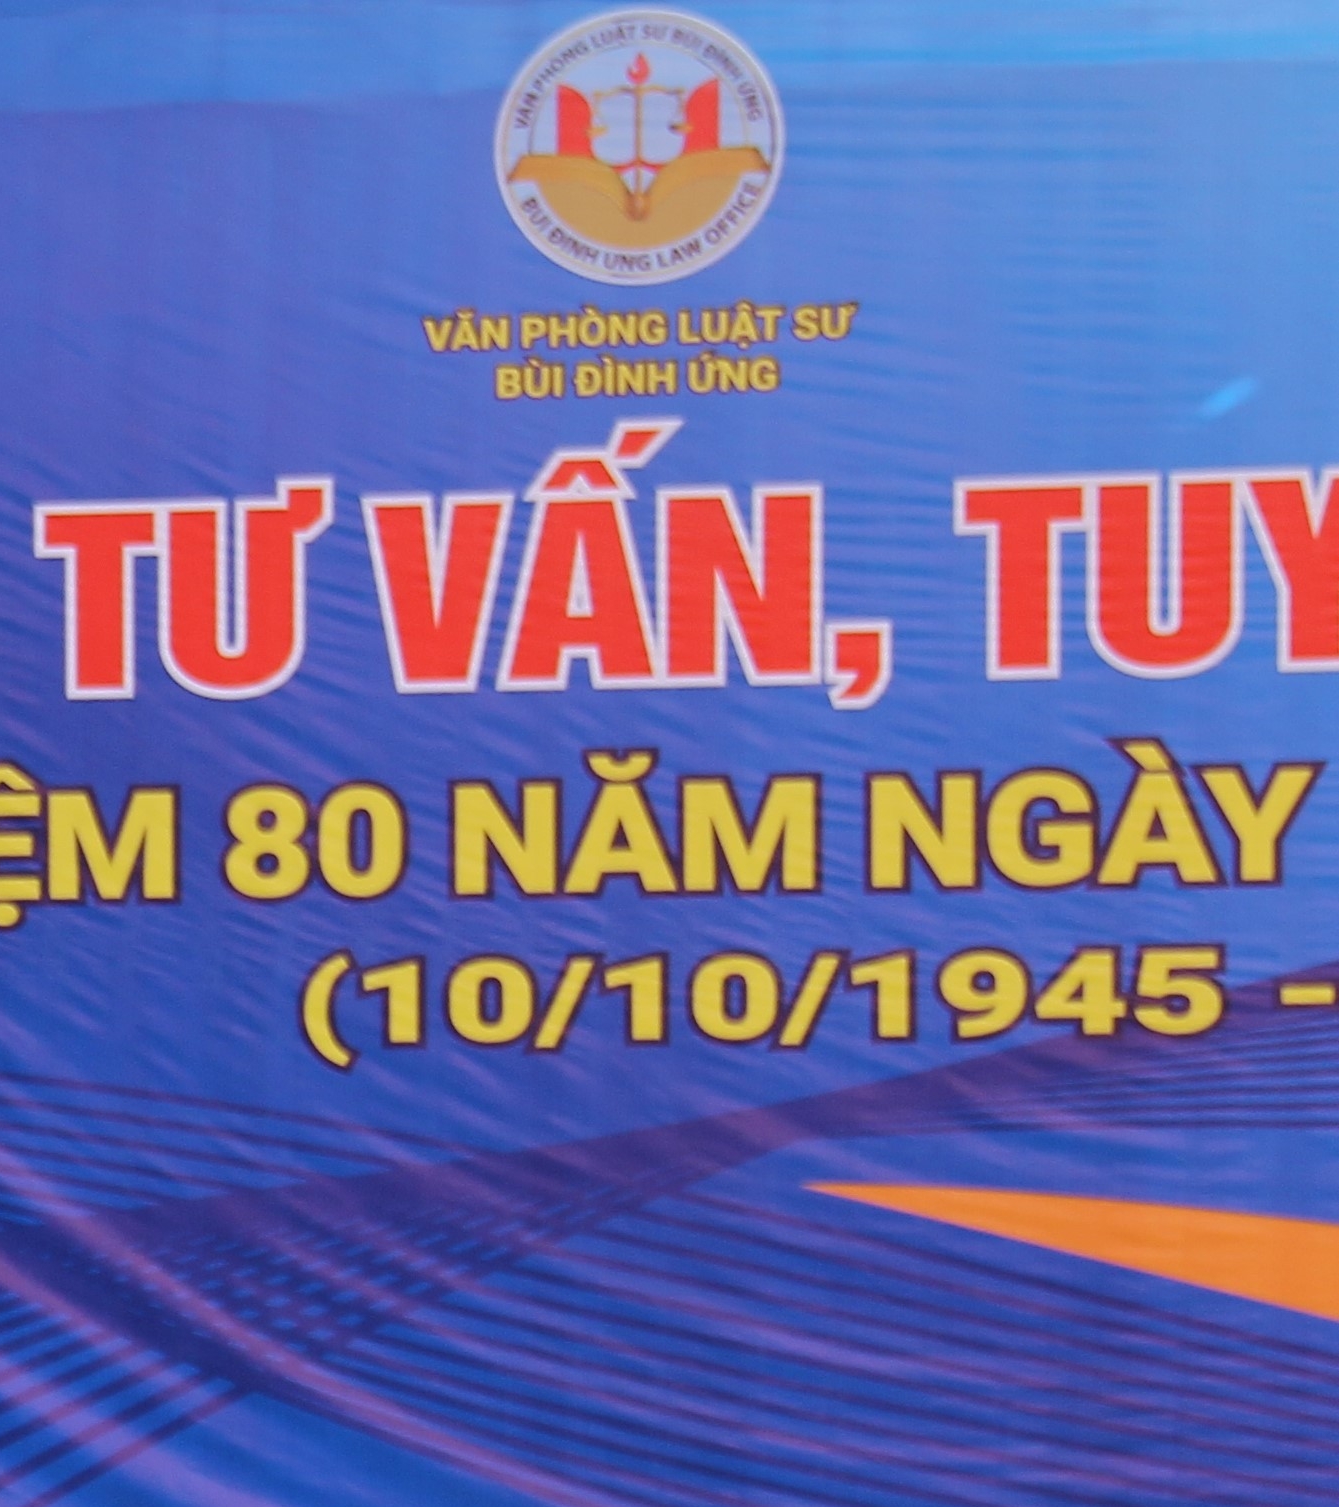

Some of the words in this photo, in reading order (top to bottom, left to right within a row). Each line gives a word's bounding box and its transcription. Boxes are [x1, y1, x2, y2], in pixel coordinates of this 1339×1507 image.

[656, 239, 703, 269] LAW
[704, 181, 762, 246] OFFICE
[423, 308, 511, 351] VĂN
[521, 303, 669, 349] PHÒNG
[677, 301, 785, 350] LUẬT
[790, 302, 859, 341] SƯ
[493, 355, 566, 400] BÙI
[572, 354, 678, 397] ĐÌNH
[686, 348, 780, 394] ỨNG
[33, 474, 335, 701] TƯ
[360, 418, 893, 711] VẤN,
[222, 779, 408, 903] 80
[449, 747, 822, 896] NĂM
[867, 737, 1324, 890] NGÀY
[301, 944, 1227, 1072] (10/10/1945
